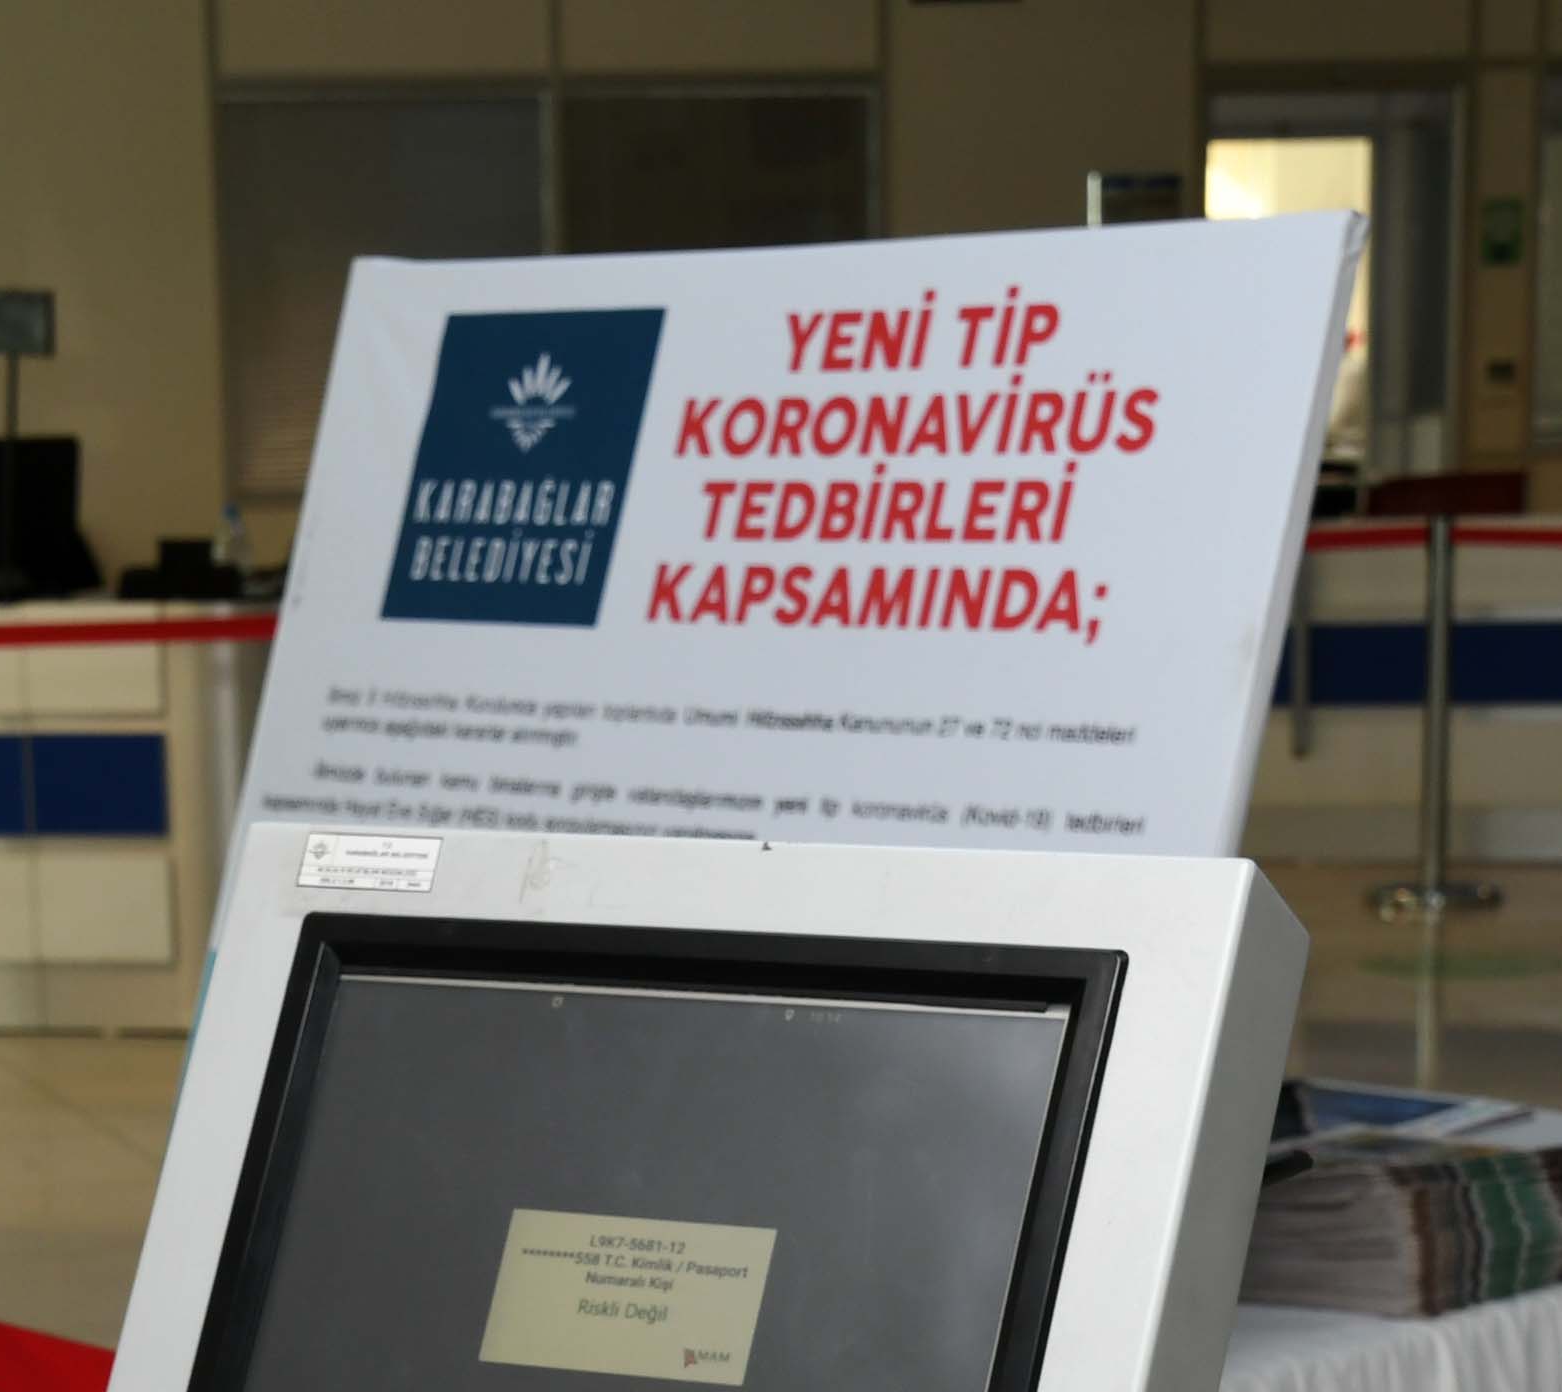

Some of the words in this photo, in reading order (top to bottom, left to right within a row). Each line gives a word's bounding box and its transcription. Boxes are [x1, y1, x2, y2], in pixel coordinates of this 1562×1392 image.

[786, 290, 937, 371] YENİ
[957, 286, 1059, 367] TİP
[675, 371, 1159, 456] KORONAVİRÜS
[412, 475, 616, 526] KARABAĞLAR
[701, 461, 1077, 541] TEDBİRLERİ
[409, 528, 595, 585] BELEDİYESİ
[645, 562, 1108, 645] KAPSAMINDA;
[686, 1262, 748, 1279] Pasaport
[577, 1299, 619, 1318] Riskli
[625, 1302, 669, 1324] Değil
